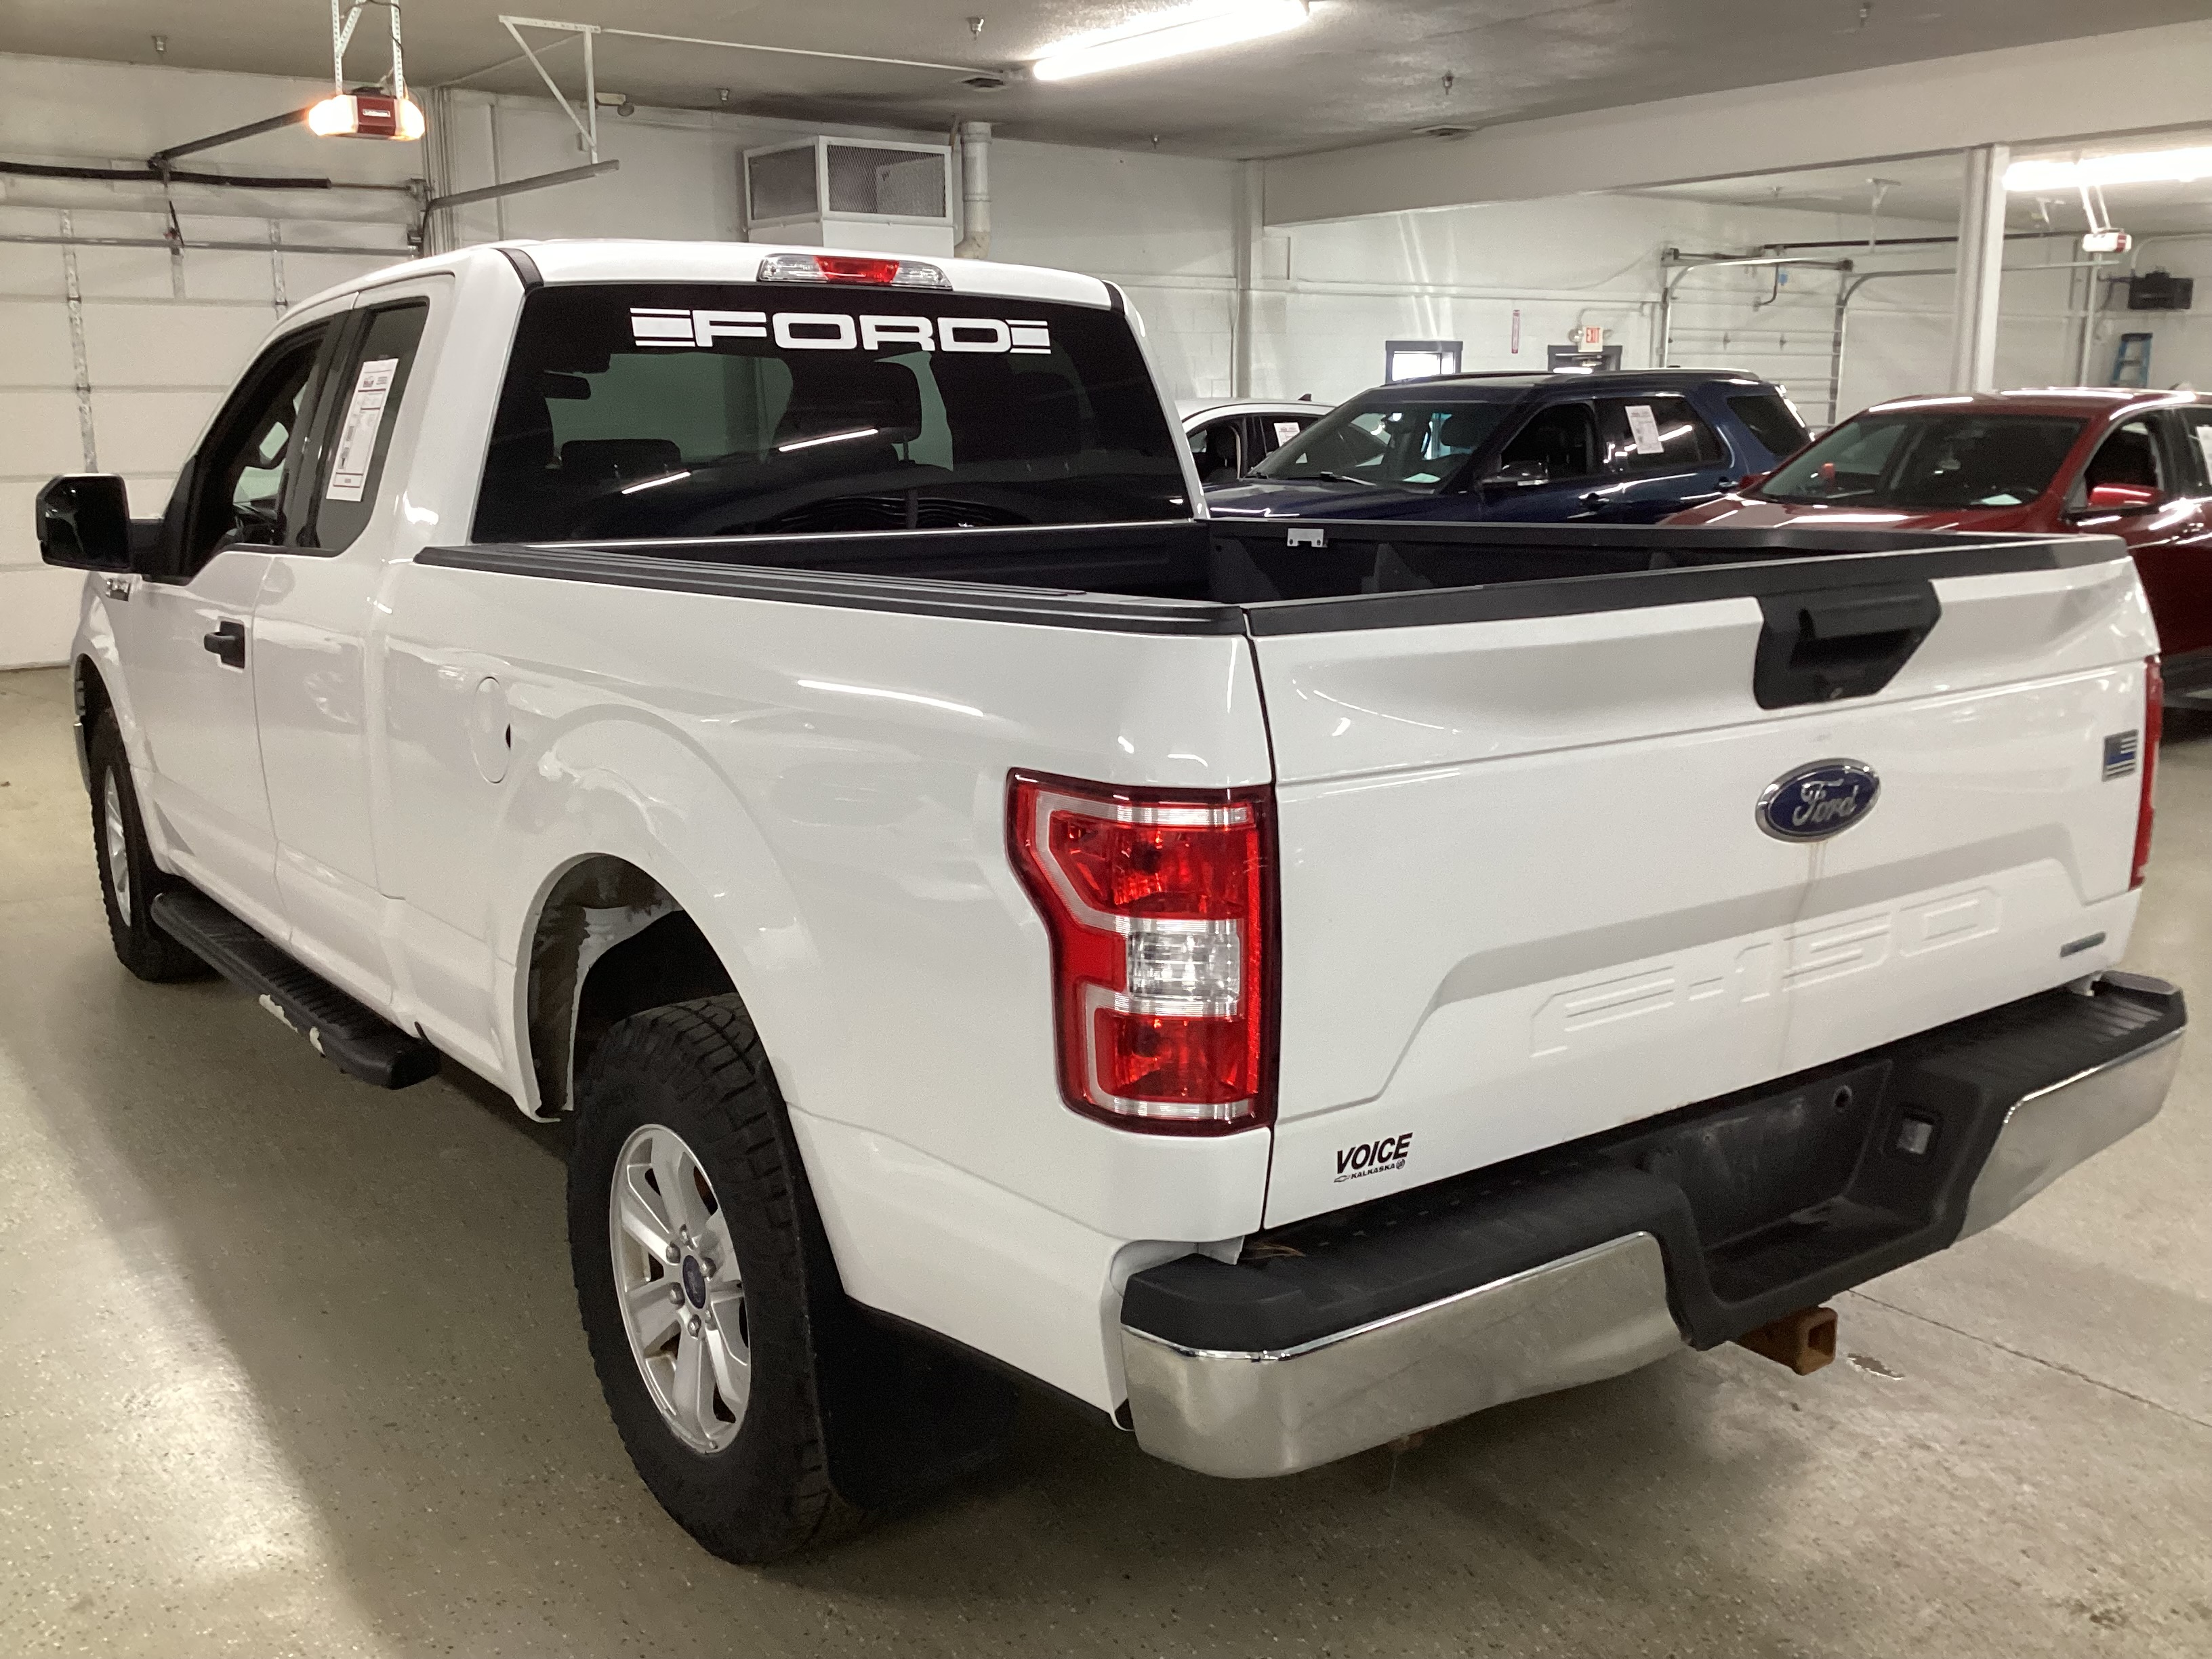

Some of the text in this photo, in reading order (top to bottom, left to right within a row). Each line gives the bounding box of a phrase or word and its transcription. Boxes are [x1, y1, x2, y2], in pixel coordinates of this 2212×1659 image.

[692, 309, 1012, 353] FORD
[1793, 778, 1859, 826] Ford
[1530, 885, 2002, 1059] F-150
[1337, 1131, 1414, 1174] VOICE
[1351, 1163, 1395, 1180] KALKASKA
